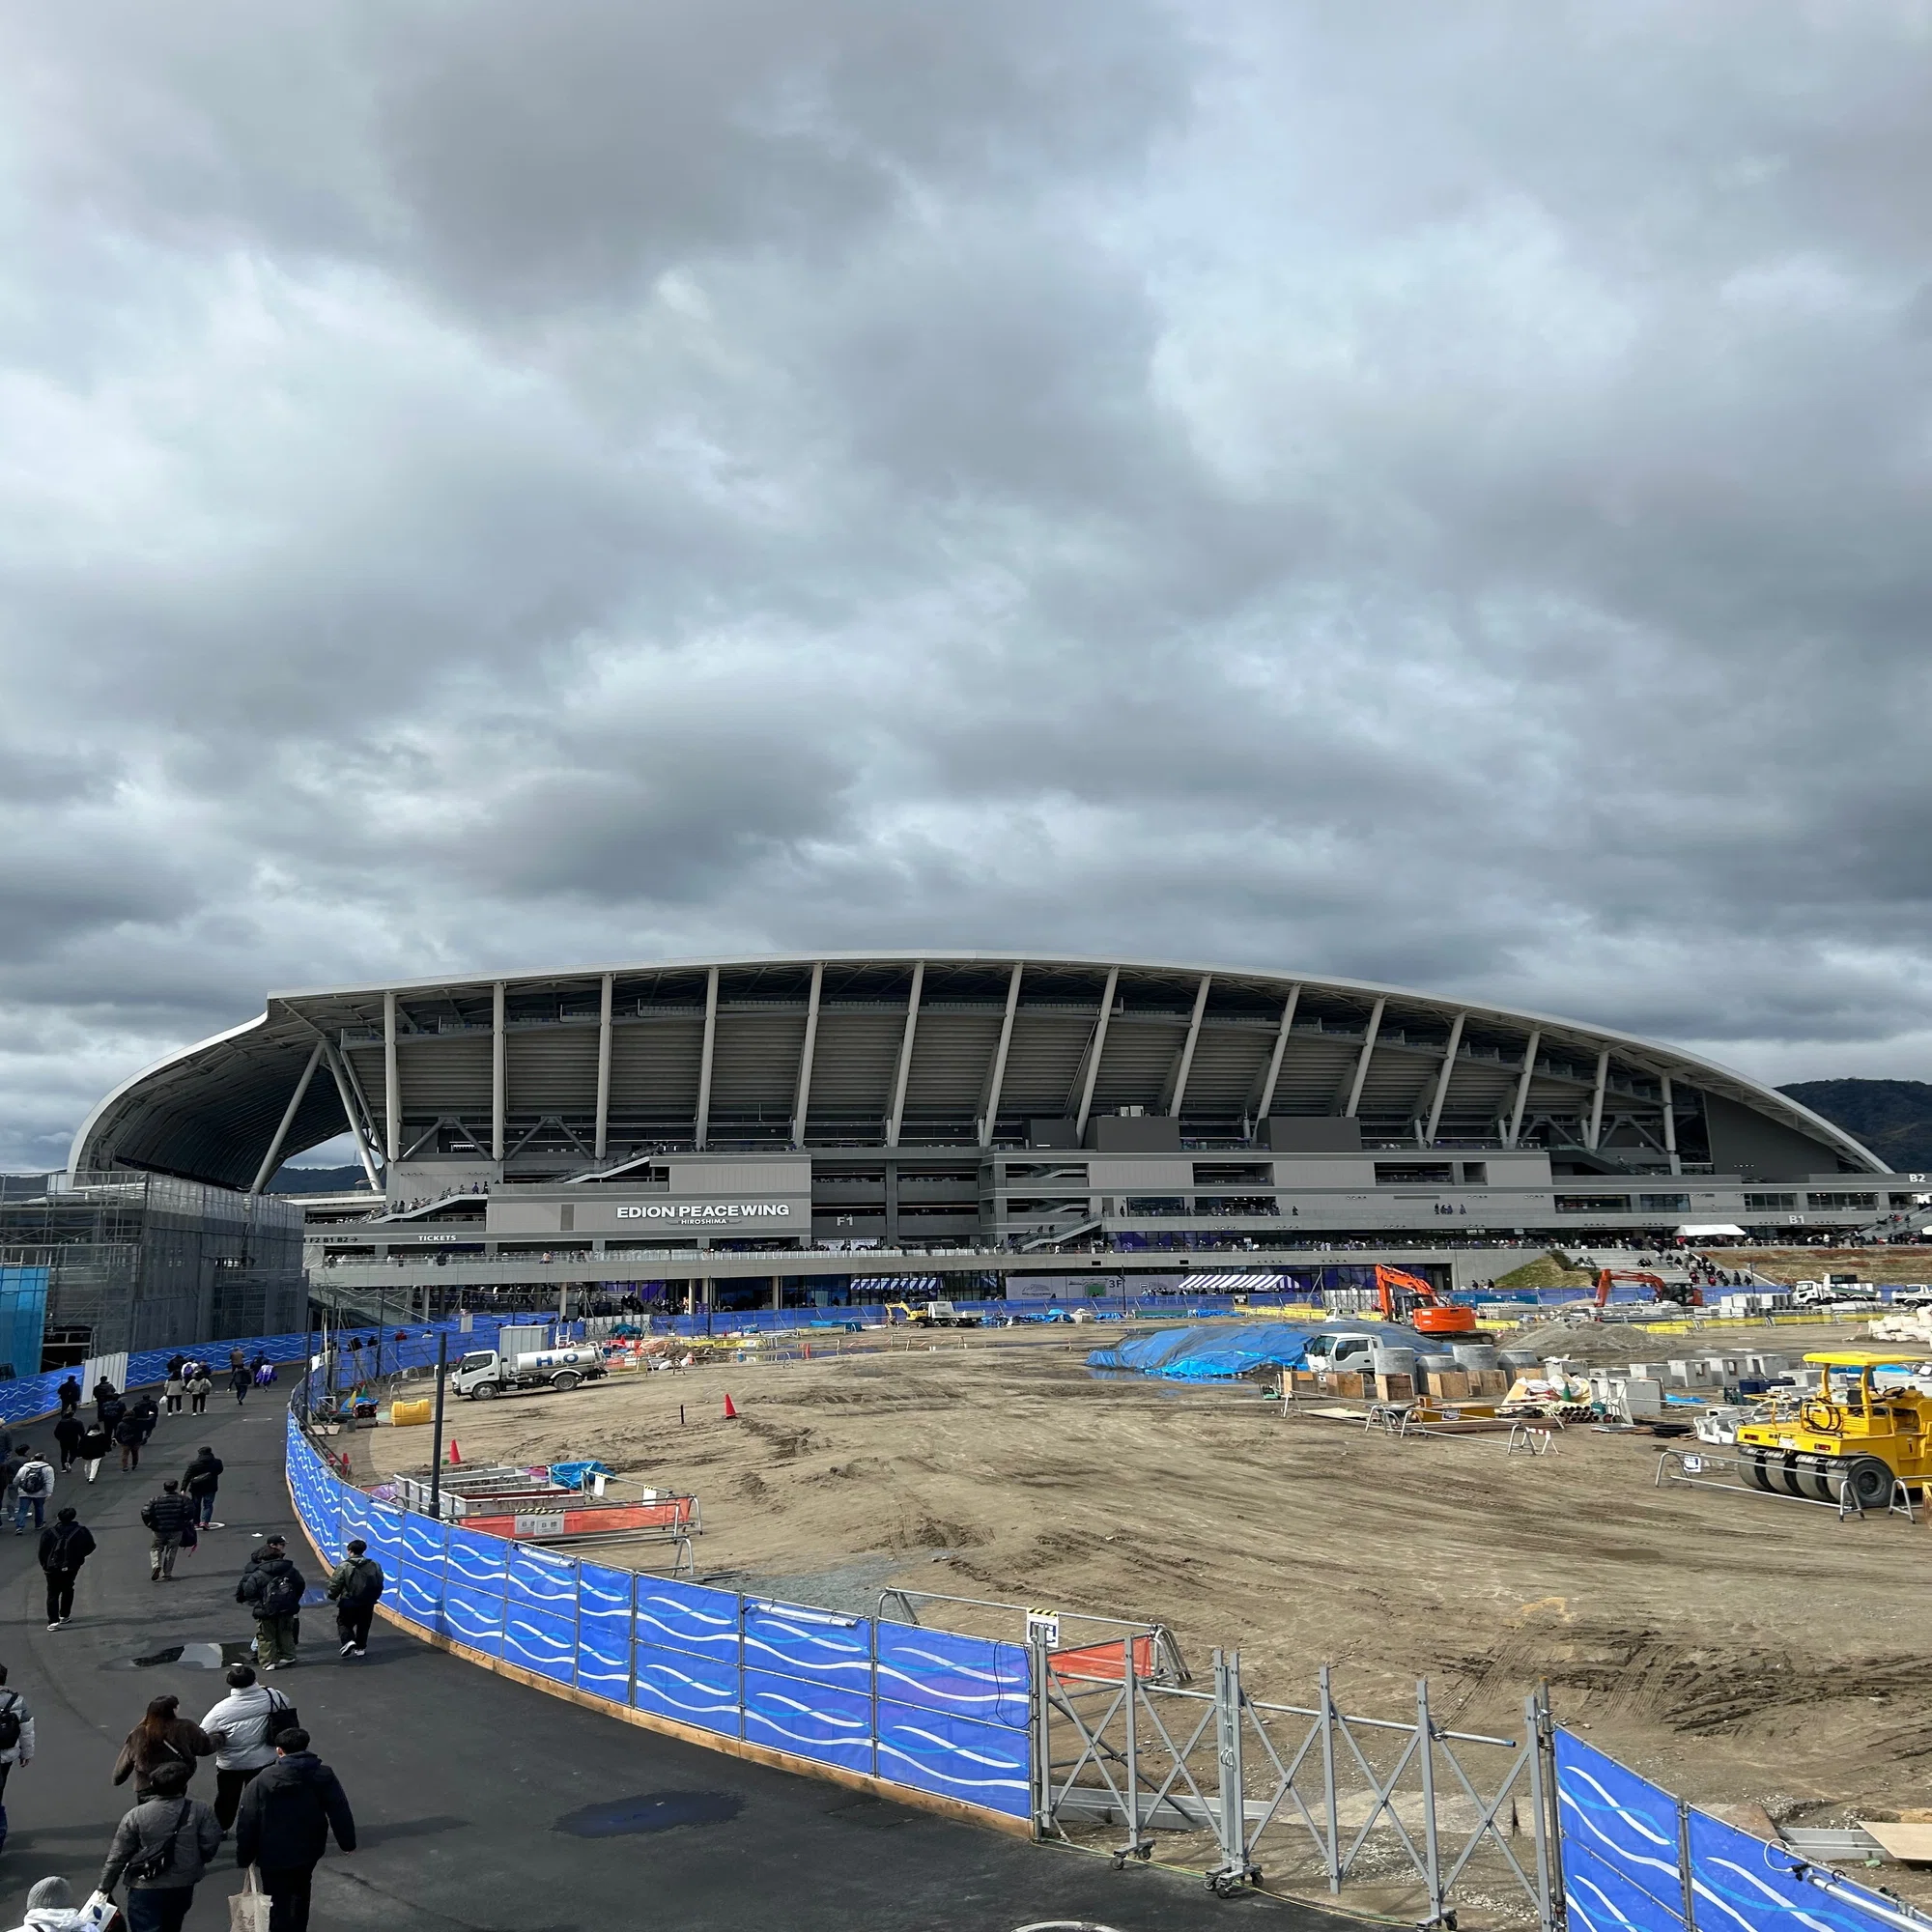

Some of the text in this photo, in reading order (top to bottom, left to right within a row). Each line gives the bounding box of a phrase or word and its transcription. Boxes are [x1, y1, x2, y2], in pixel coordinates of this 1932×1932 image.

[1908, 1174, 1926, 1182] B2
[616, 1204, 790, 1219] EDION PEACE WING
[837, 1215, 853, 1226] F1
[1788, 1214, 1804, 1224] B1
[535, 1353, 580, 1367] H2O
